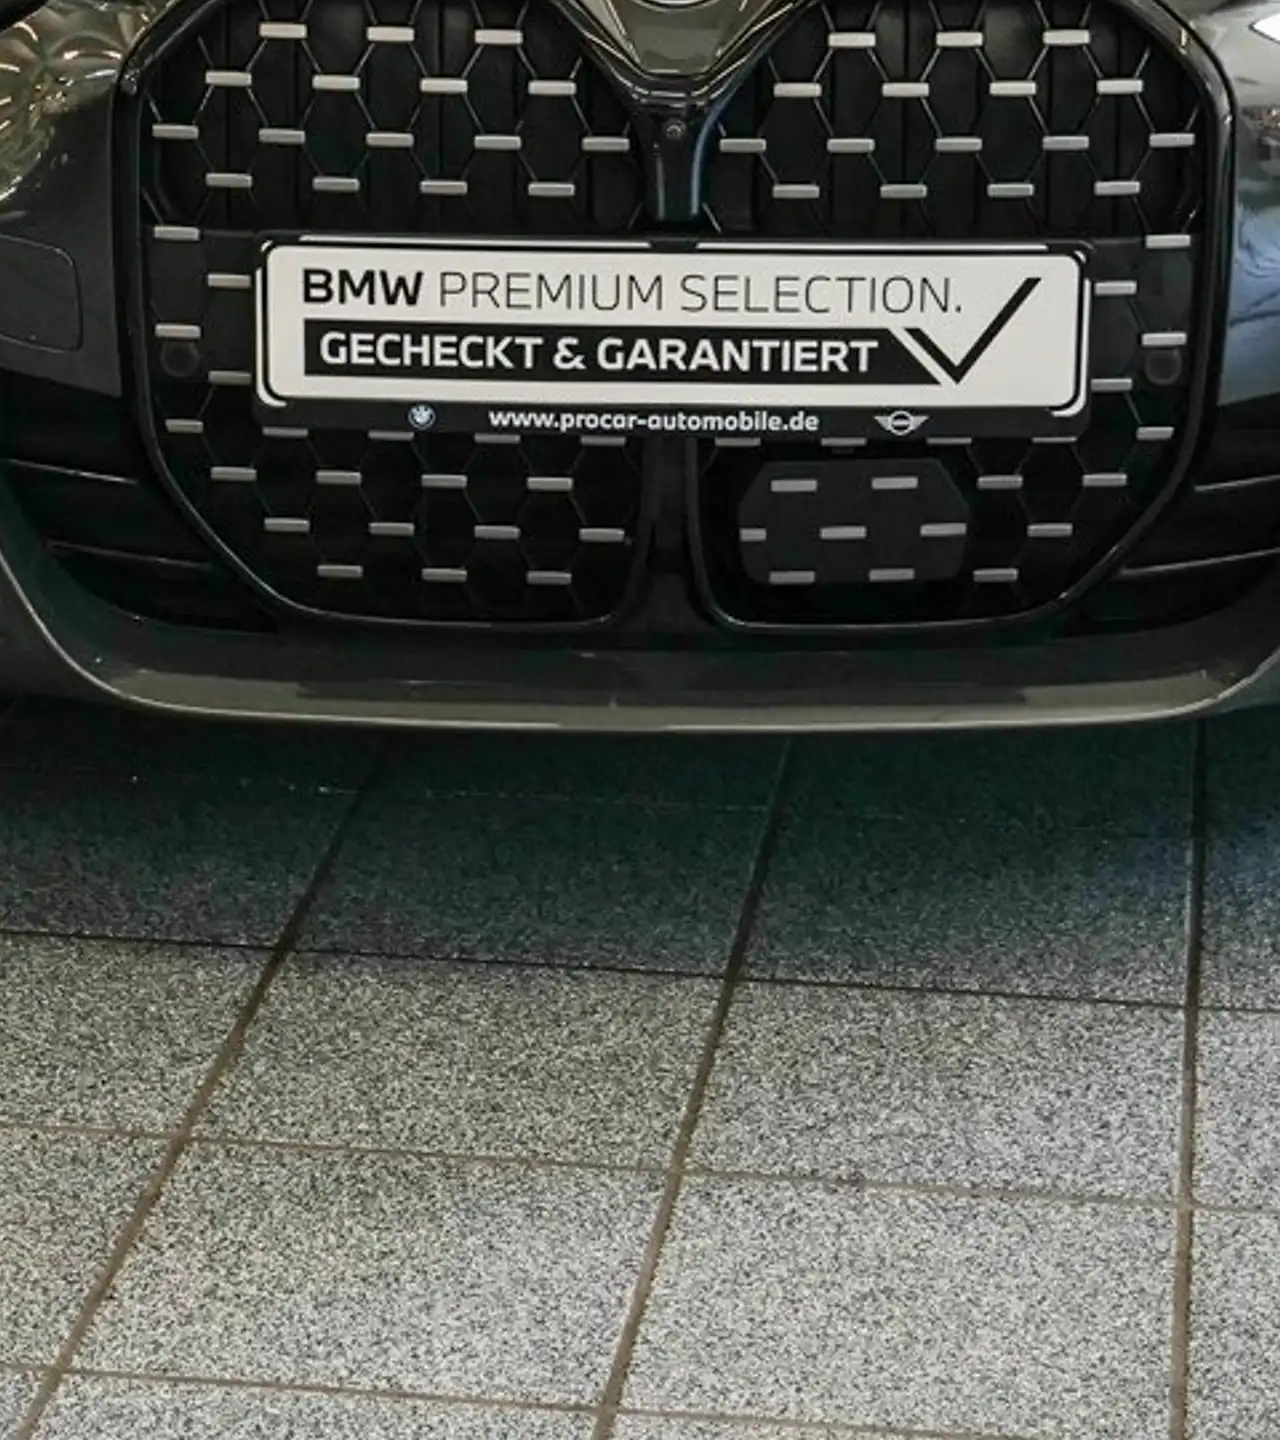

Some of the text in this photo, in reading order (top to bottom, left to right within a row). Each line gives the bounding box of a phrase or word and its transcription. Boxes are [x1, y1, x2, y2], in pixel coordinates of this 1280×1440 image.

[303, 268, 962, 314] BMW PREMIUM SELECTION.
[320, 331, 879, 373] GECHECKT & GARANTIERT
[488, 410, 820, 432] www.procar-automobile.de
